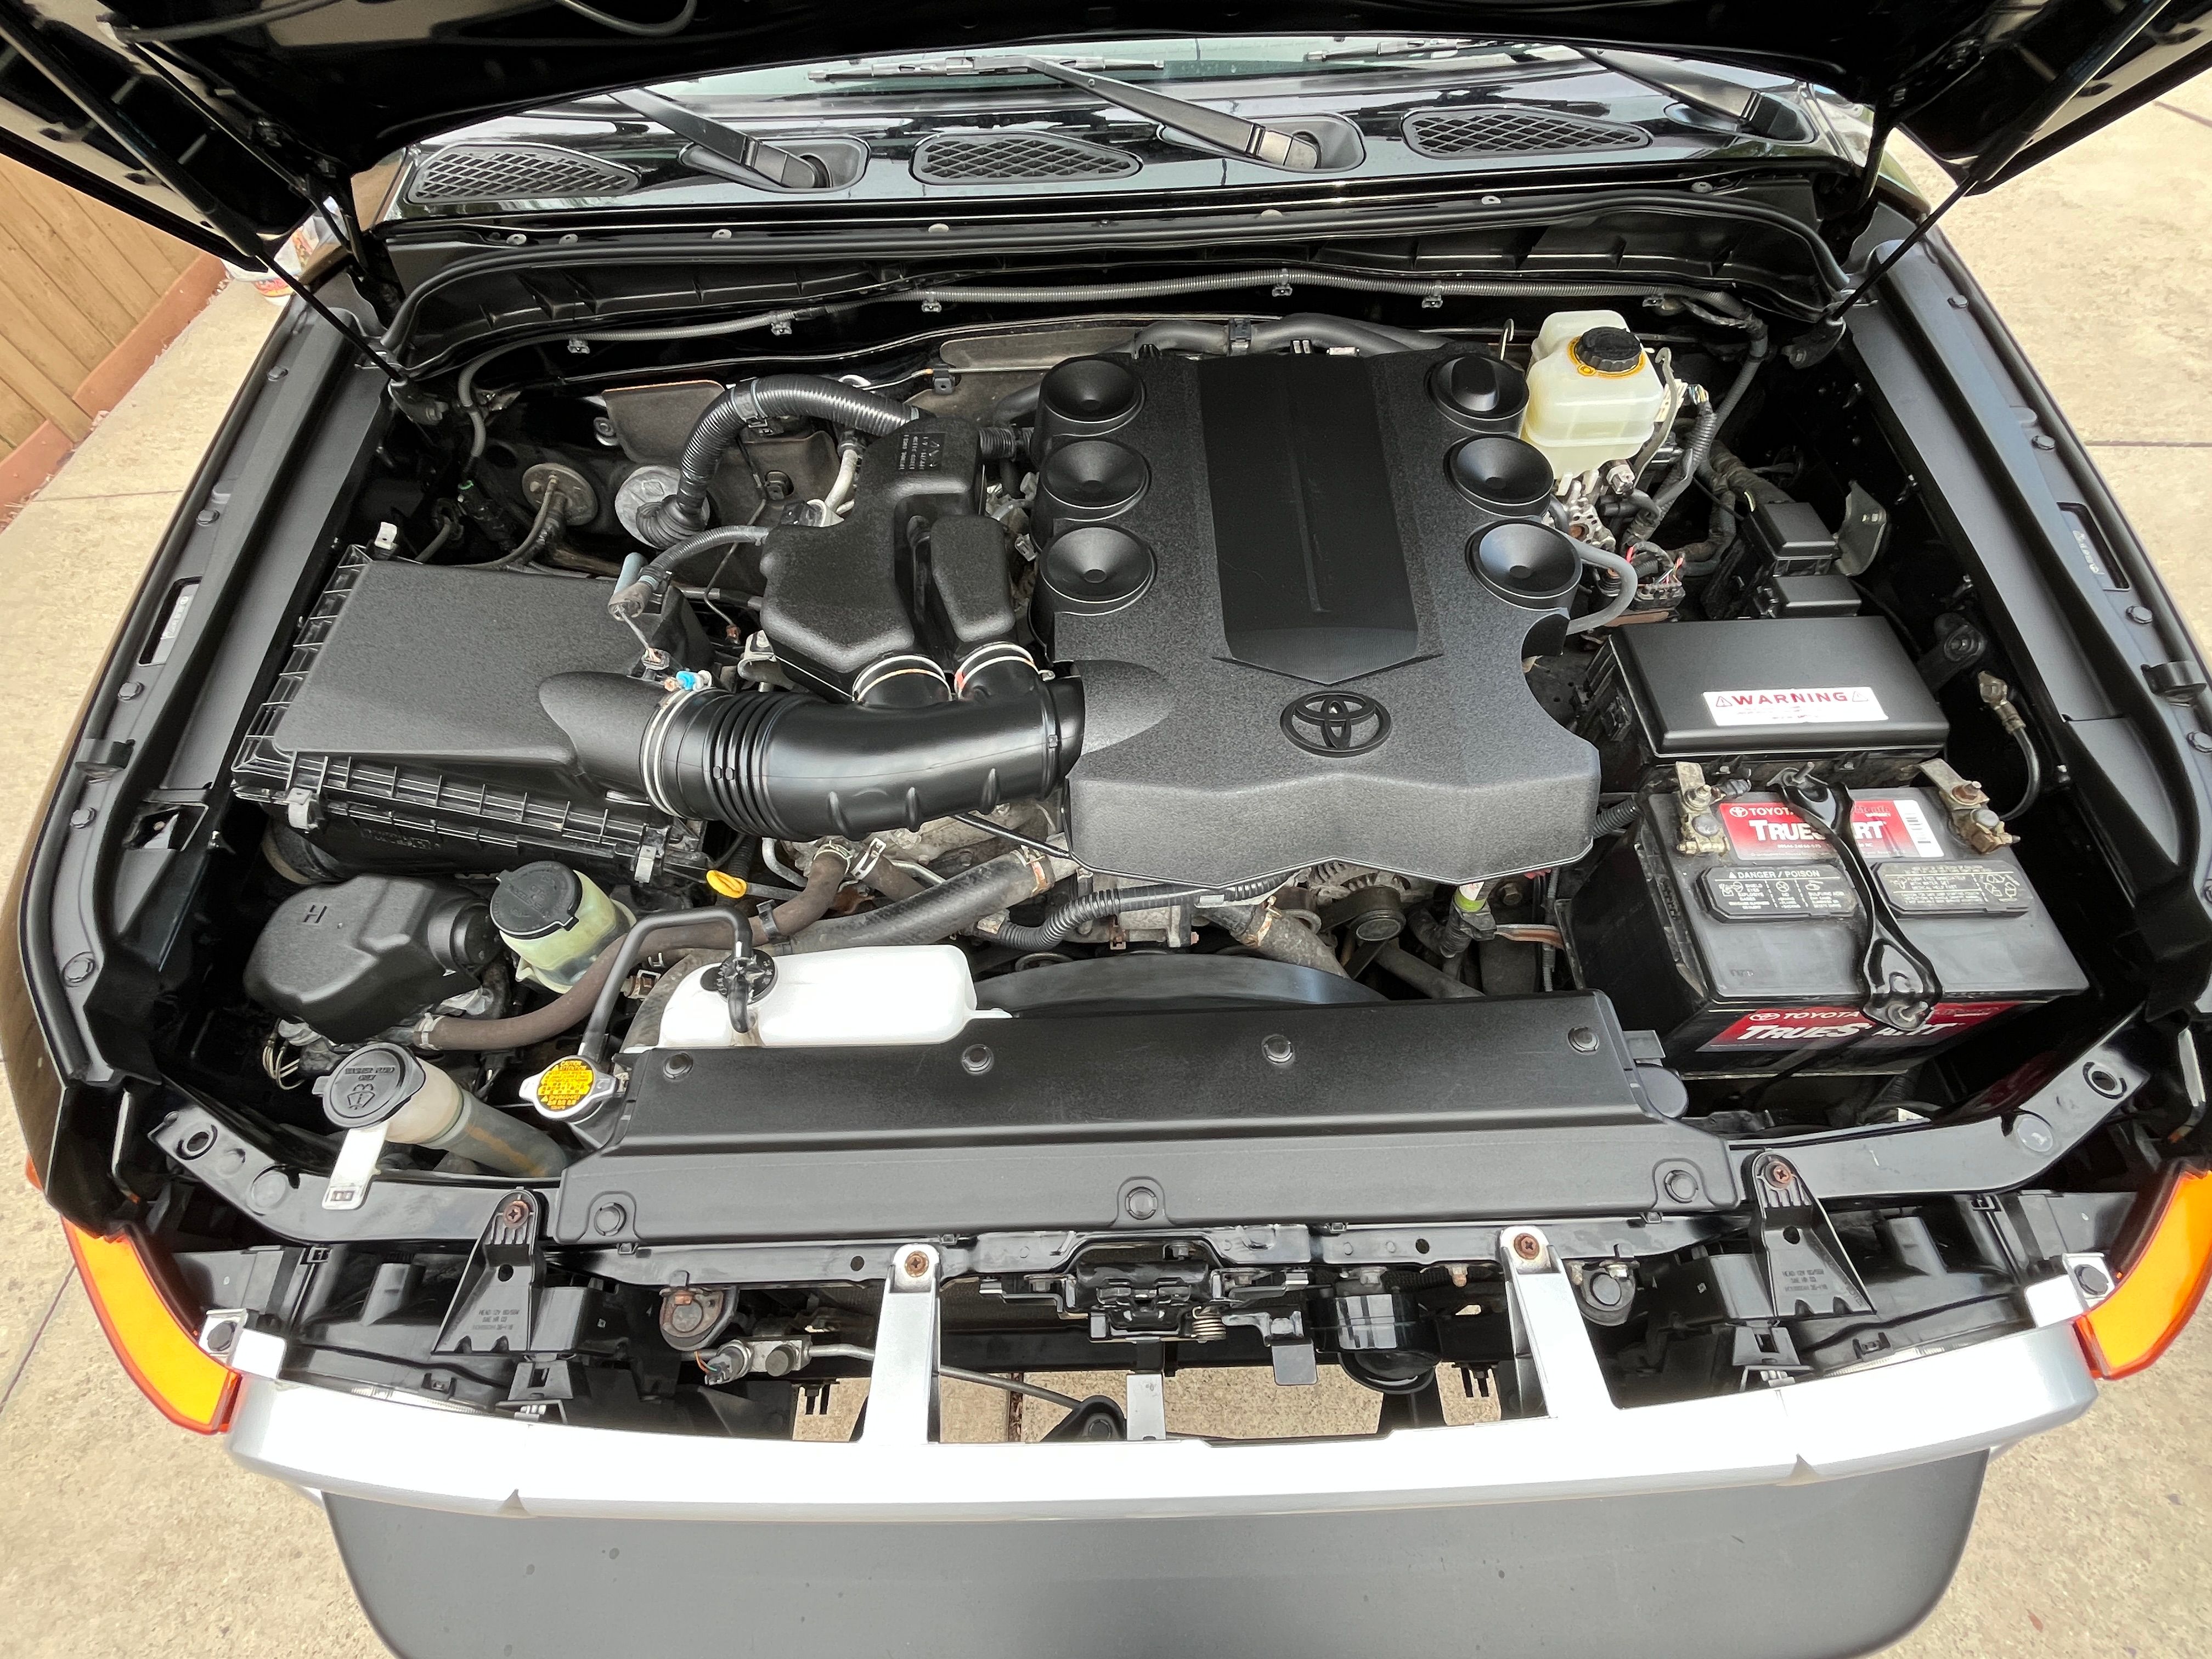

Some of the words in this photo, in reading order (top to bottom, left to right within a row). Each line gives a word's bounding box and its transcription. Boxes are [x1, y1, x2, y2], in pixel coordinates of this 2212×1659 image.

[1731, 692, 1848, 705] WARNING
[1748, 807, 1794, 816] TOYOT
[303, 905, 328, 923] H
